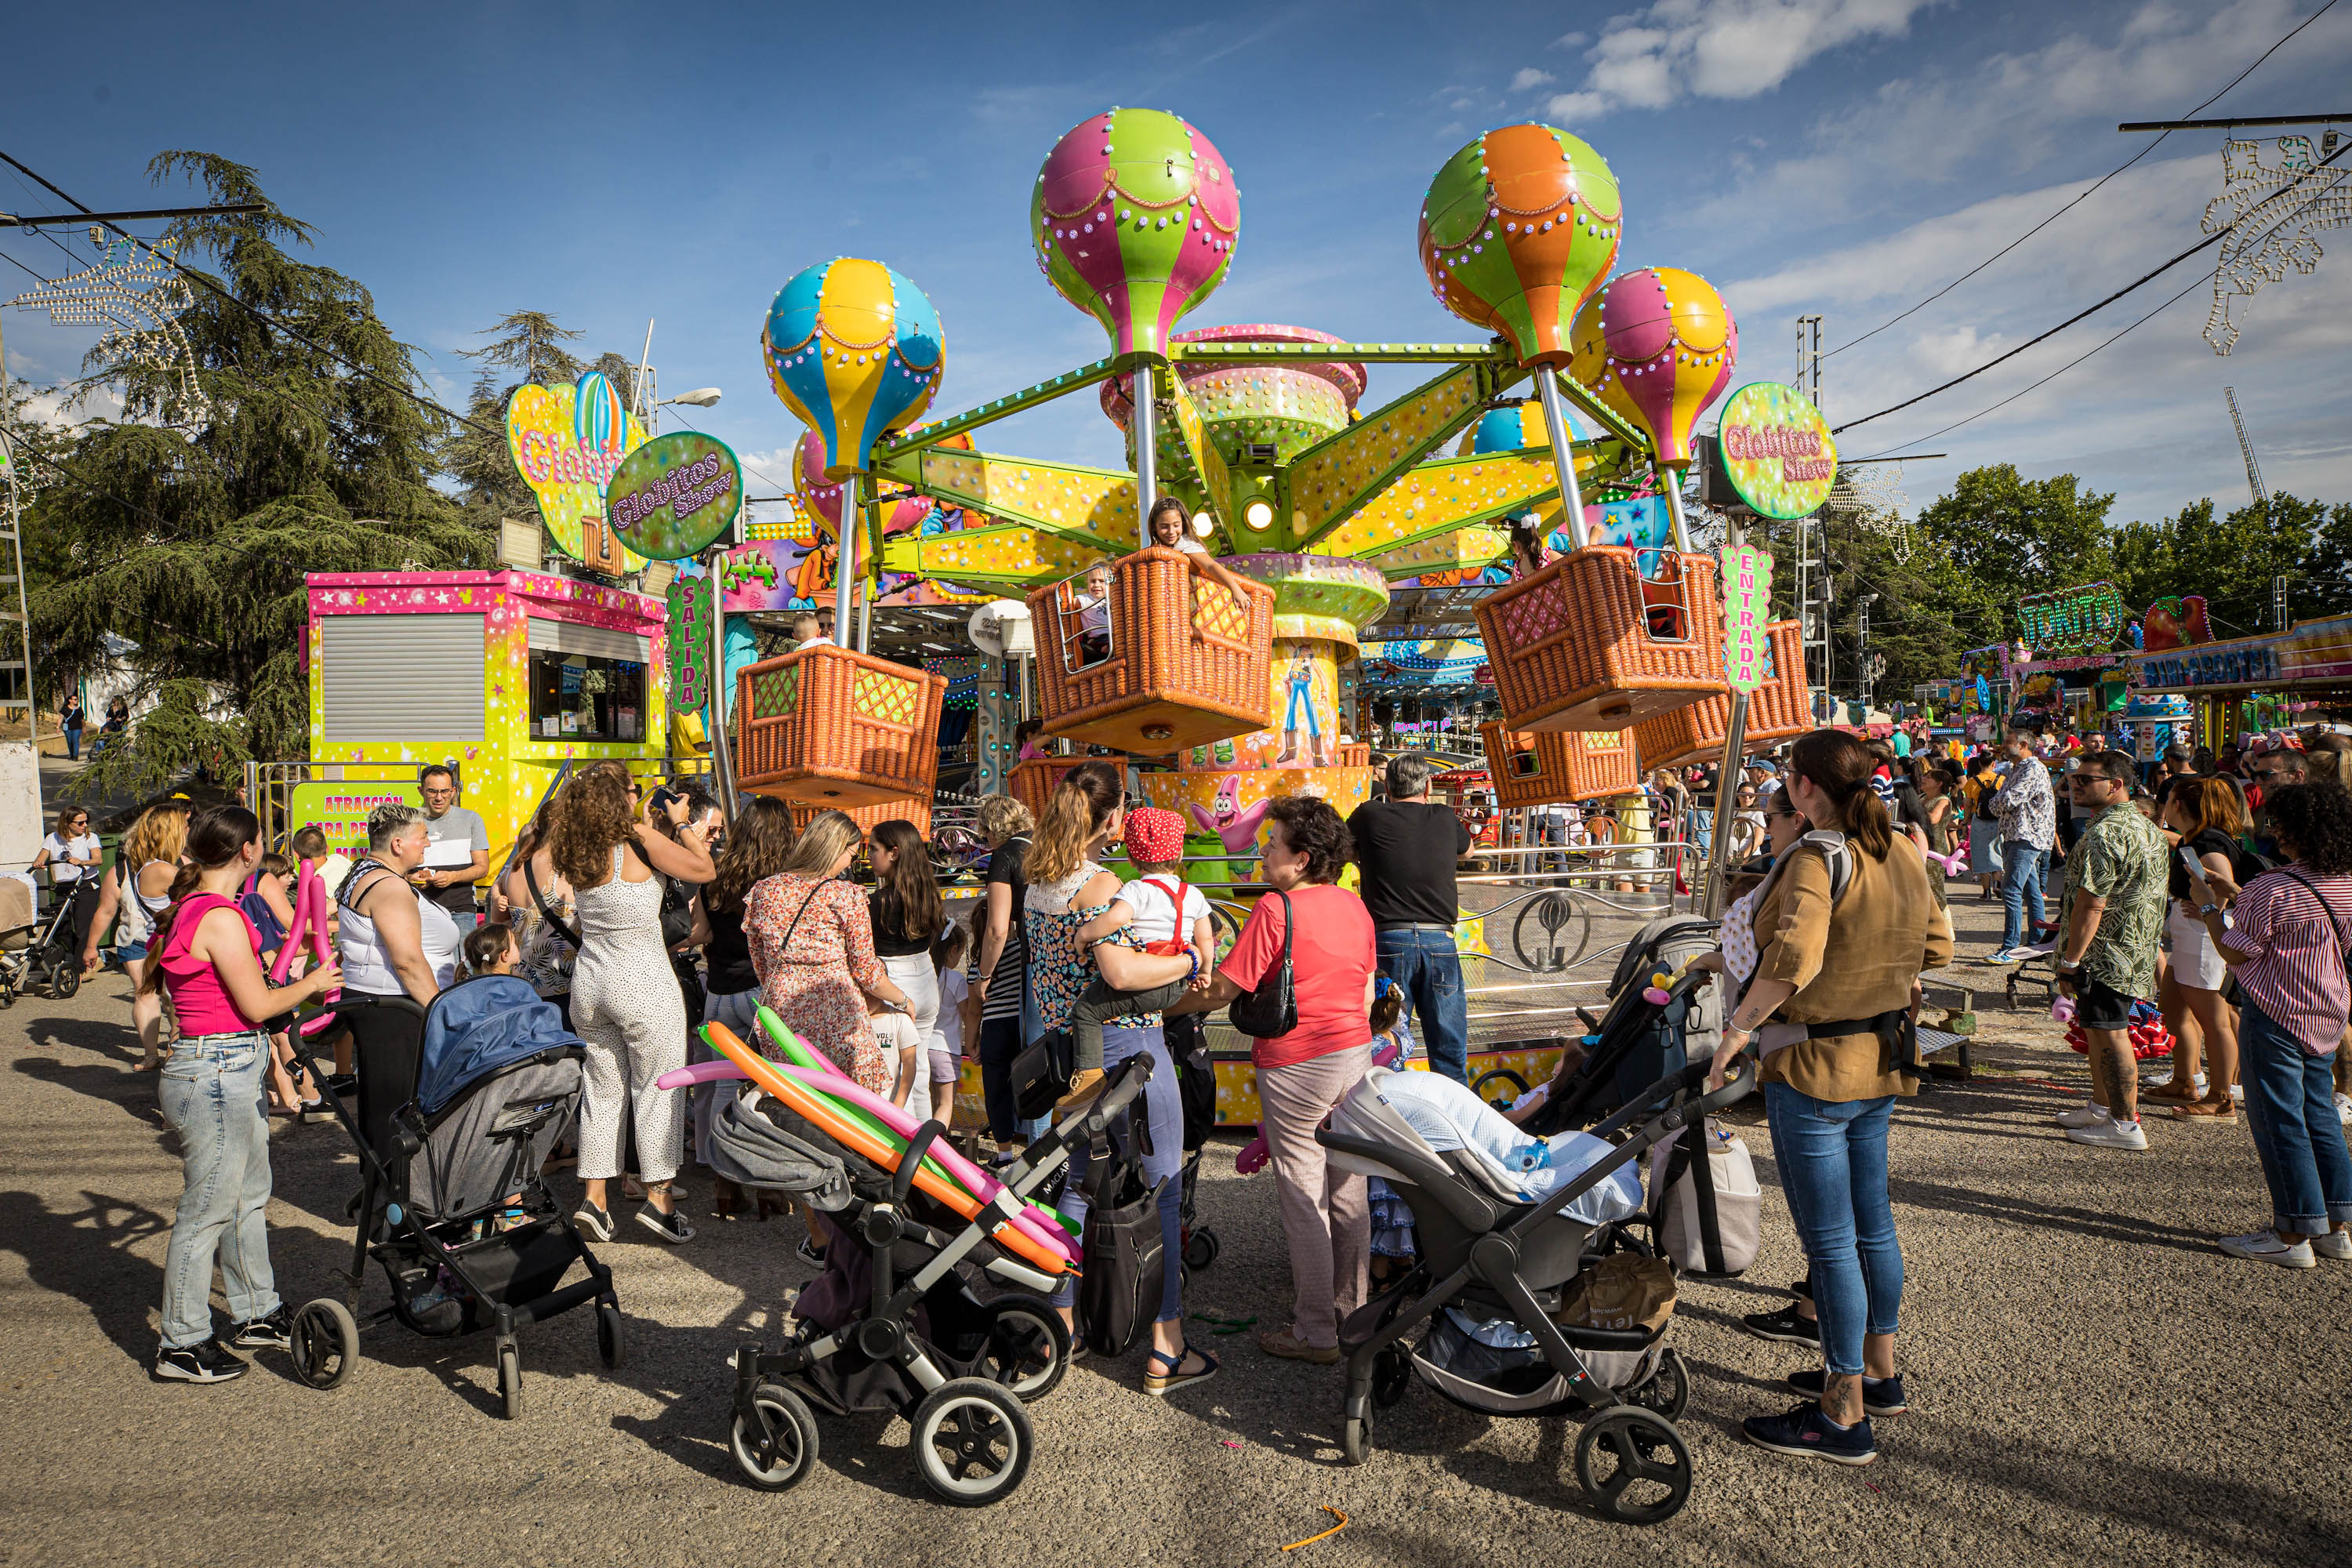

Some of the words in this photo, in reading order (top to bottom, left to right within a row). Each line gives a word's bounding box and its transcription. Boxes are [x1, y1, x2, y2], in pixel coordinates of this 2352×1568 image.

[1726, 424, 1821, 461] Globitos
[612, 452, 720, 531] Globitos
[1782, 455, 1833, 483] Show
[673, 470, 733, 520] Show
[1737, 554, 1754, 683] ENTRADA
[2021, 593, 2116, 644] TOKITO
[680, 586, 696, 704] SALIDA
[305, 821, 345, 840] RA
[1043, 1160, 1071, 1195] MACLAR
